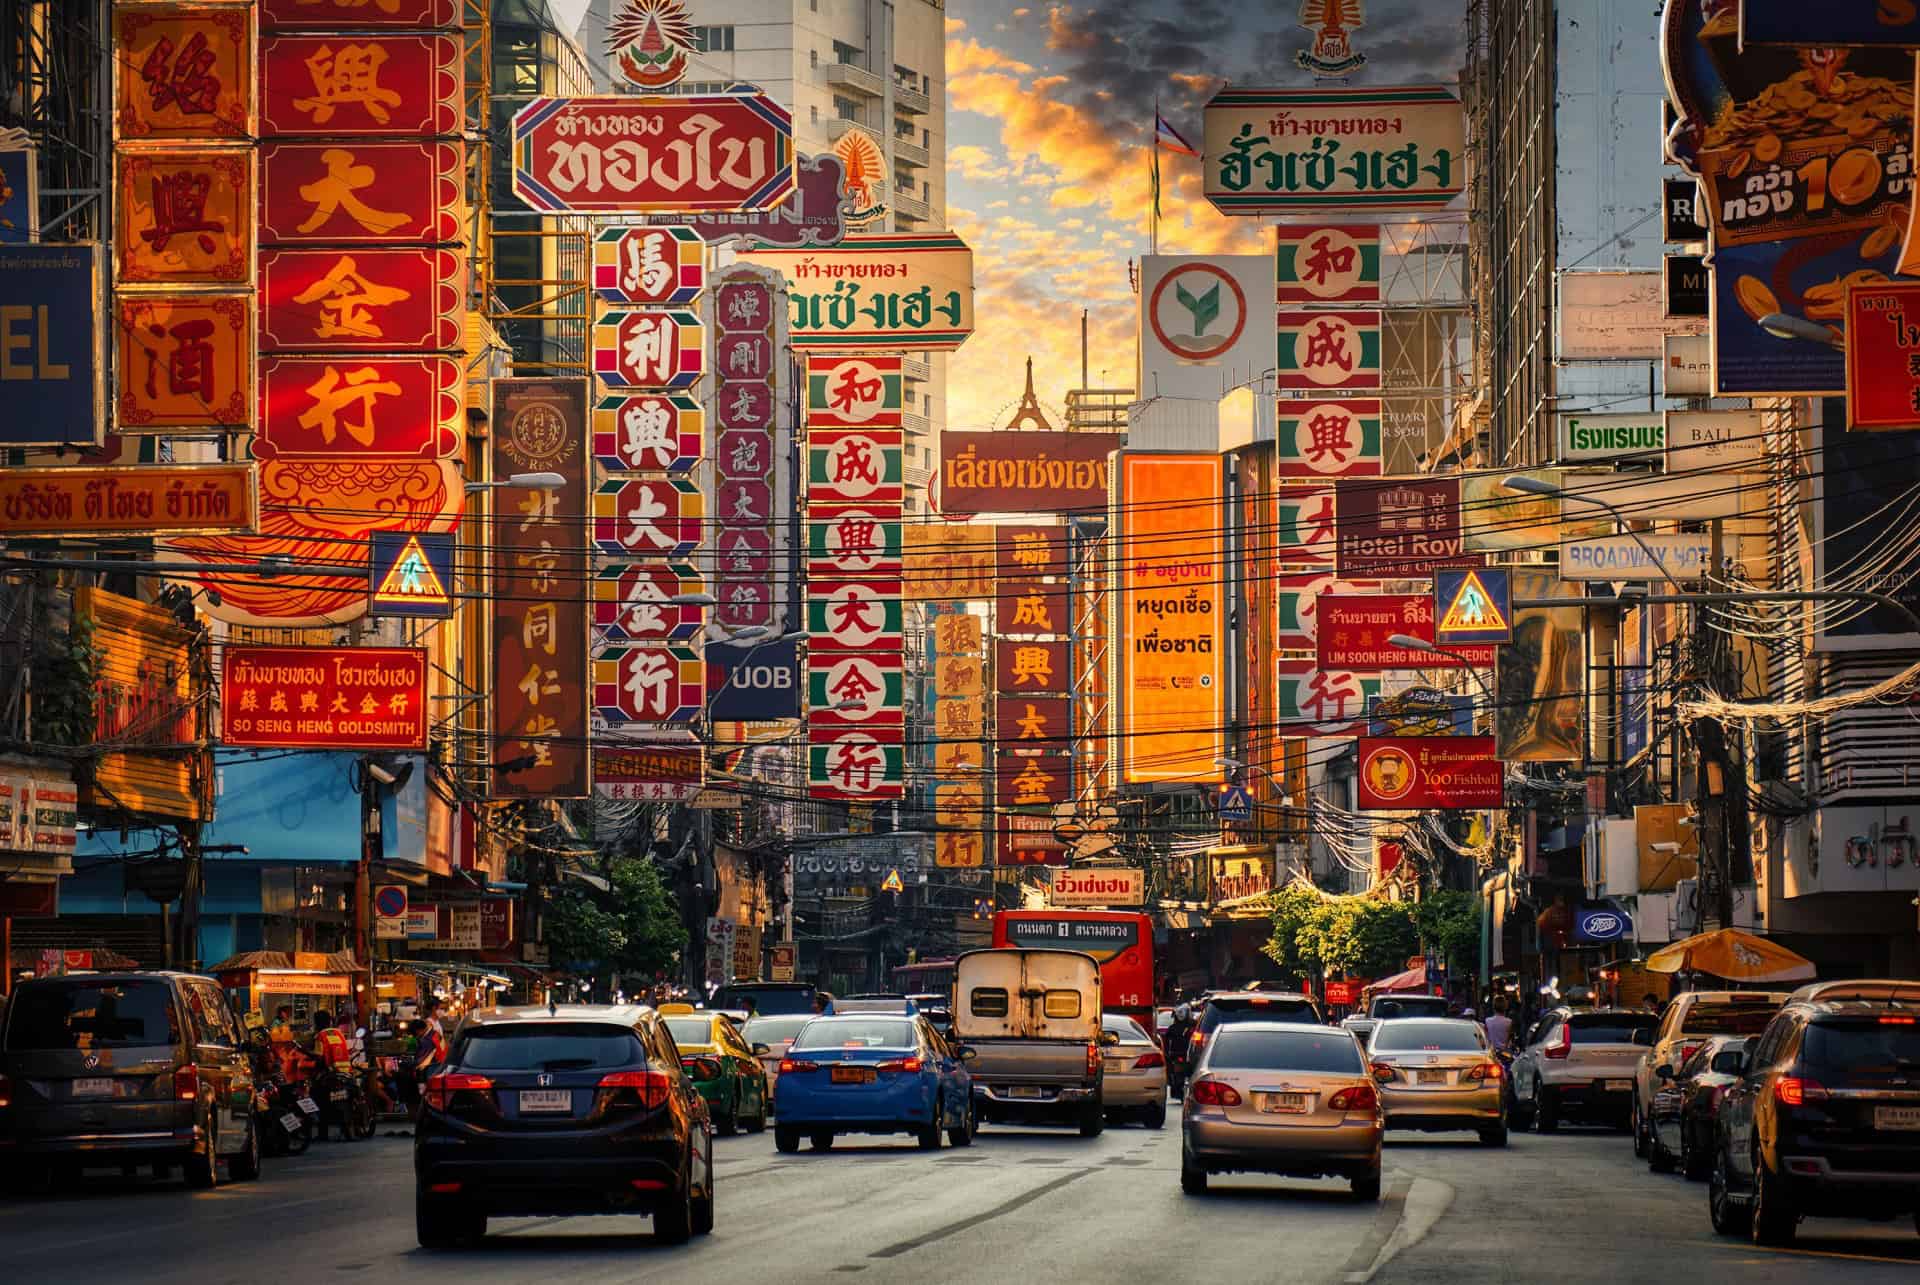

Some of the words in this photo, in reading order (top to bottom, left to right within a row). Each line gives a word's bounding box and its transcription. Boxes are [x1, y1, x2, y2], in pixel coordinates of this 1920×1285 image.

[556, 106, 664, 136] ห้างทอง
[1269, 111, 1402, 136] ห้างขายทอง
[292, 0, 413, 446] 興大金行
[795, 257, 908, 278] ห้างขายทอง
[1343, 535, 1404, 555] Hotel
[1570, 546, 1667, 568] BROADWAY
[828, 368, 883, 790] 和成興大金行
[1136, 588, 1212, 620] หยุดเชื้อ
[1136, 627, 1212, 653] เพื่อชาติ
[1328, 651, 1346, 664] LIM
[1348, 651, 1377, 663] SOON
[1379, 651, 1407, 663] HENG
[234, 659, 325, 685] ห้างขายทอง
[732, 666, 792, 689] UOB
[239, 688, 409, 717] 蘇成興大金行
[233, 719, 252, 732] SO
[256, 719, 292, 733] SENG
[296, 720, 334, 734] HENG
[338, 720, 415, 735] GOLDSMITH
[1454, 773, 1499, 785] Fishball
[1075, 924, 1128, 937] สนามหลวง
[1588, 916, 1617, 933] Boots
